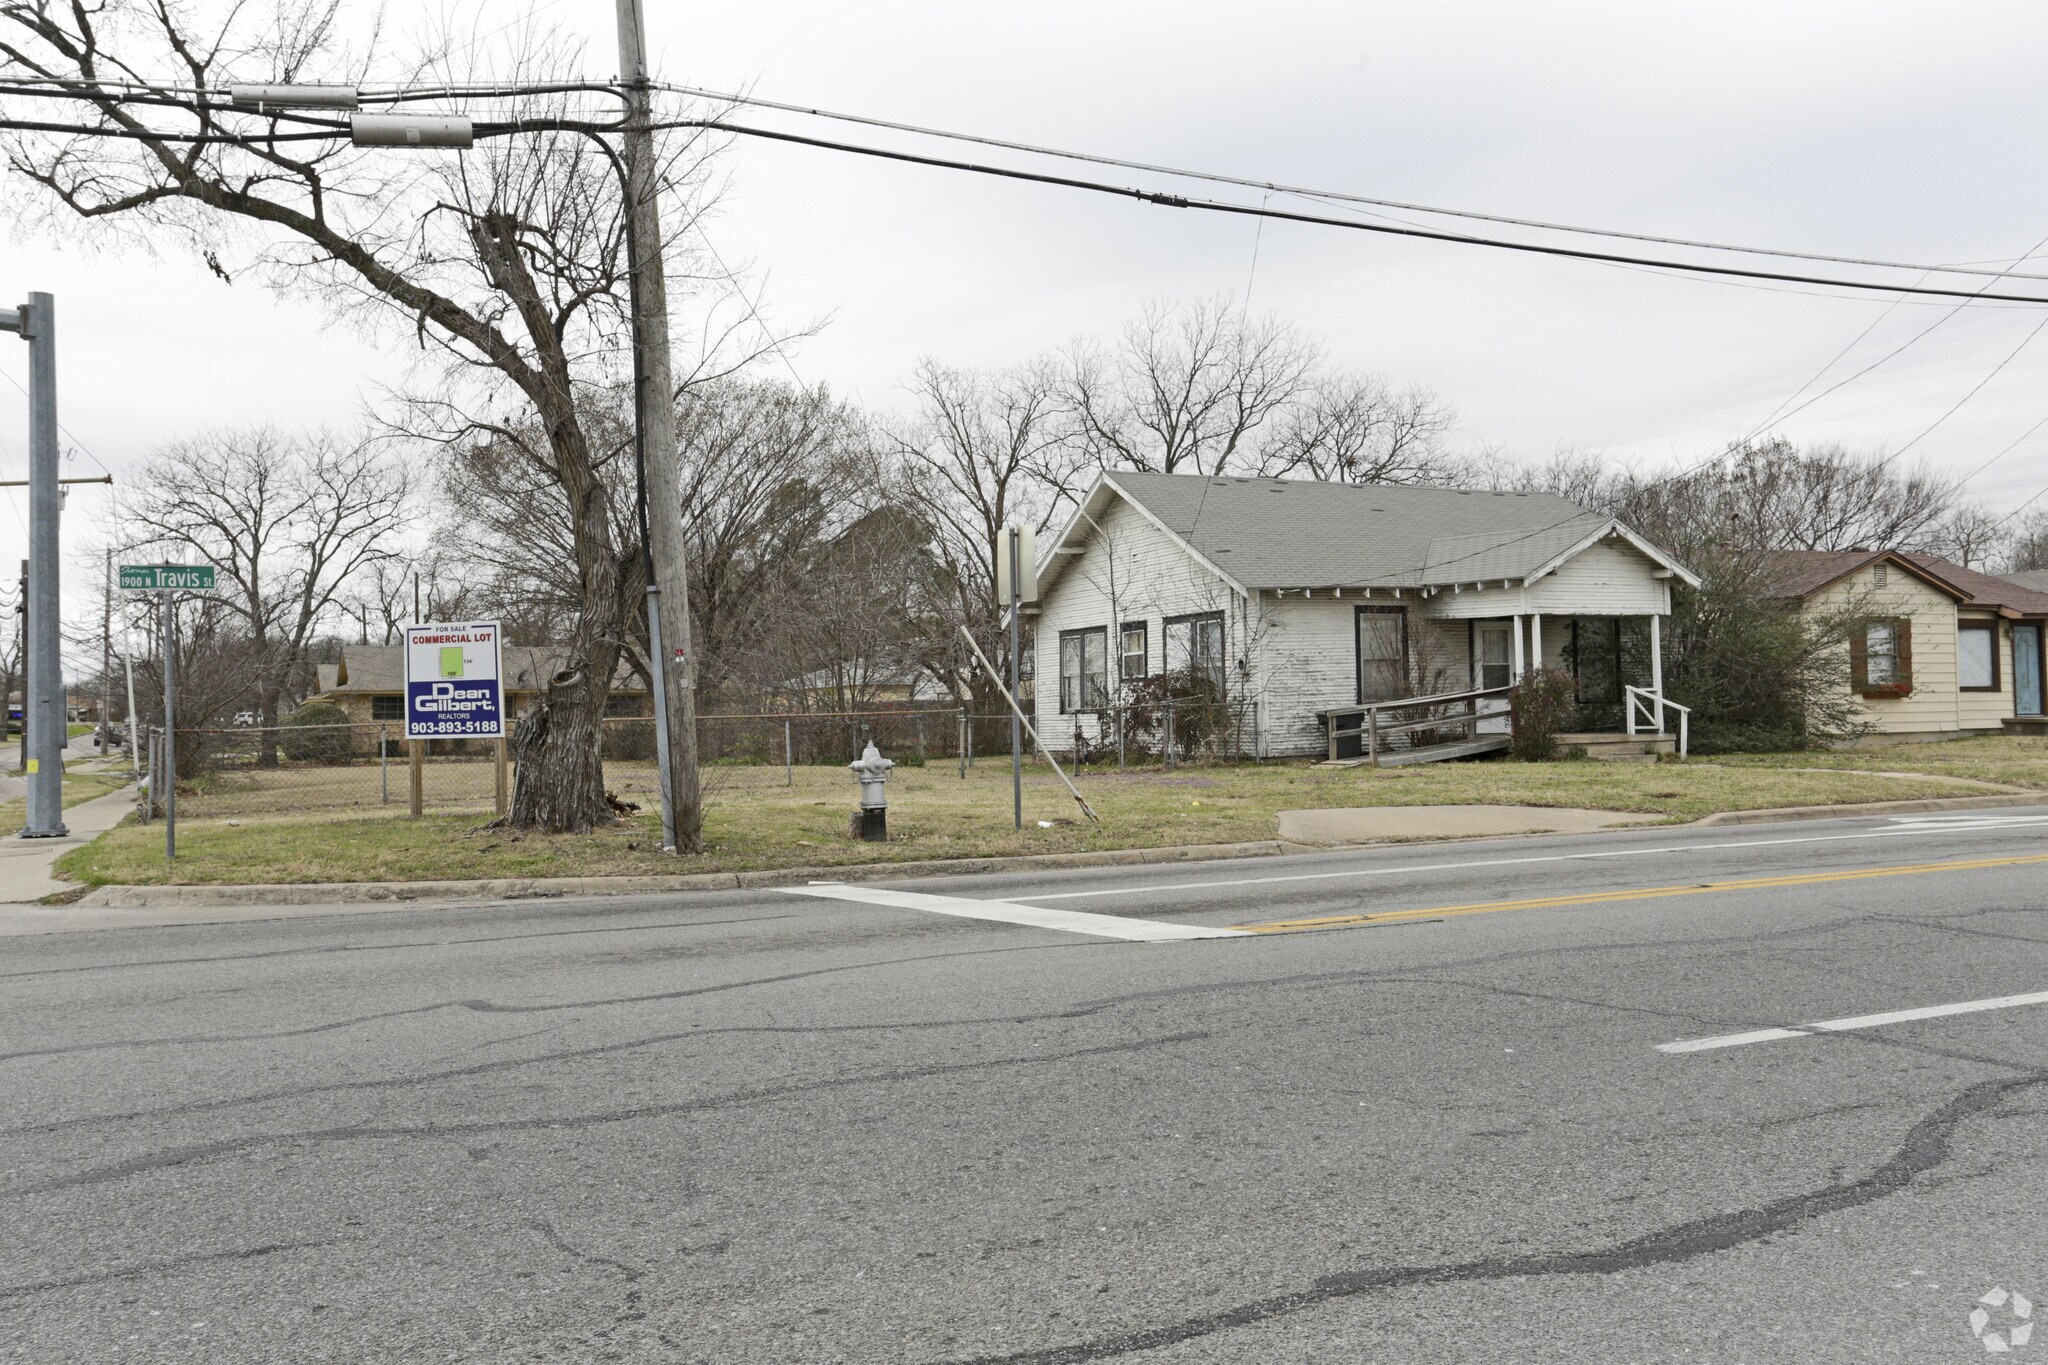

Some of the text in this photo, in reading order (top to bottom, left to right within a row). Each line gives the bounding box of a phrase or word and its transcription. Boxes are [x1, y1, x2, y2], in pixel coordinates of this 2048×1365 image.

[121, 577, 142, 587] 1900
[145, 577, 151, 587] N
[154, 569, 200, 587] Travis
[413, 633, 492, 644] COMMERCIAL LOT
[432, 682, 490, 700] Dean
[411, 721, 497, 733] 903-893-5188
